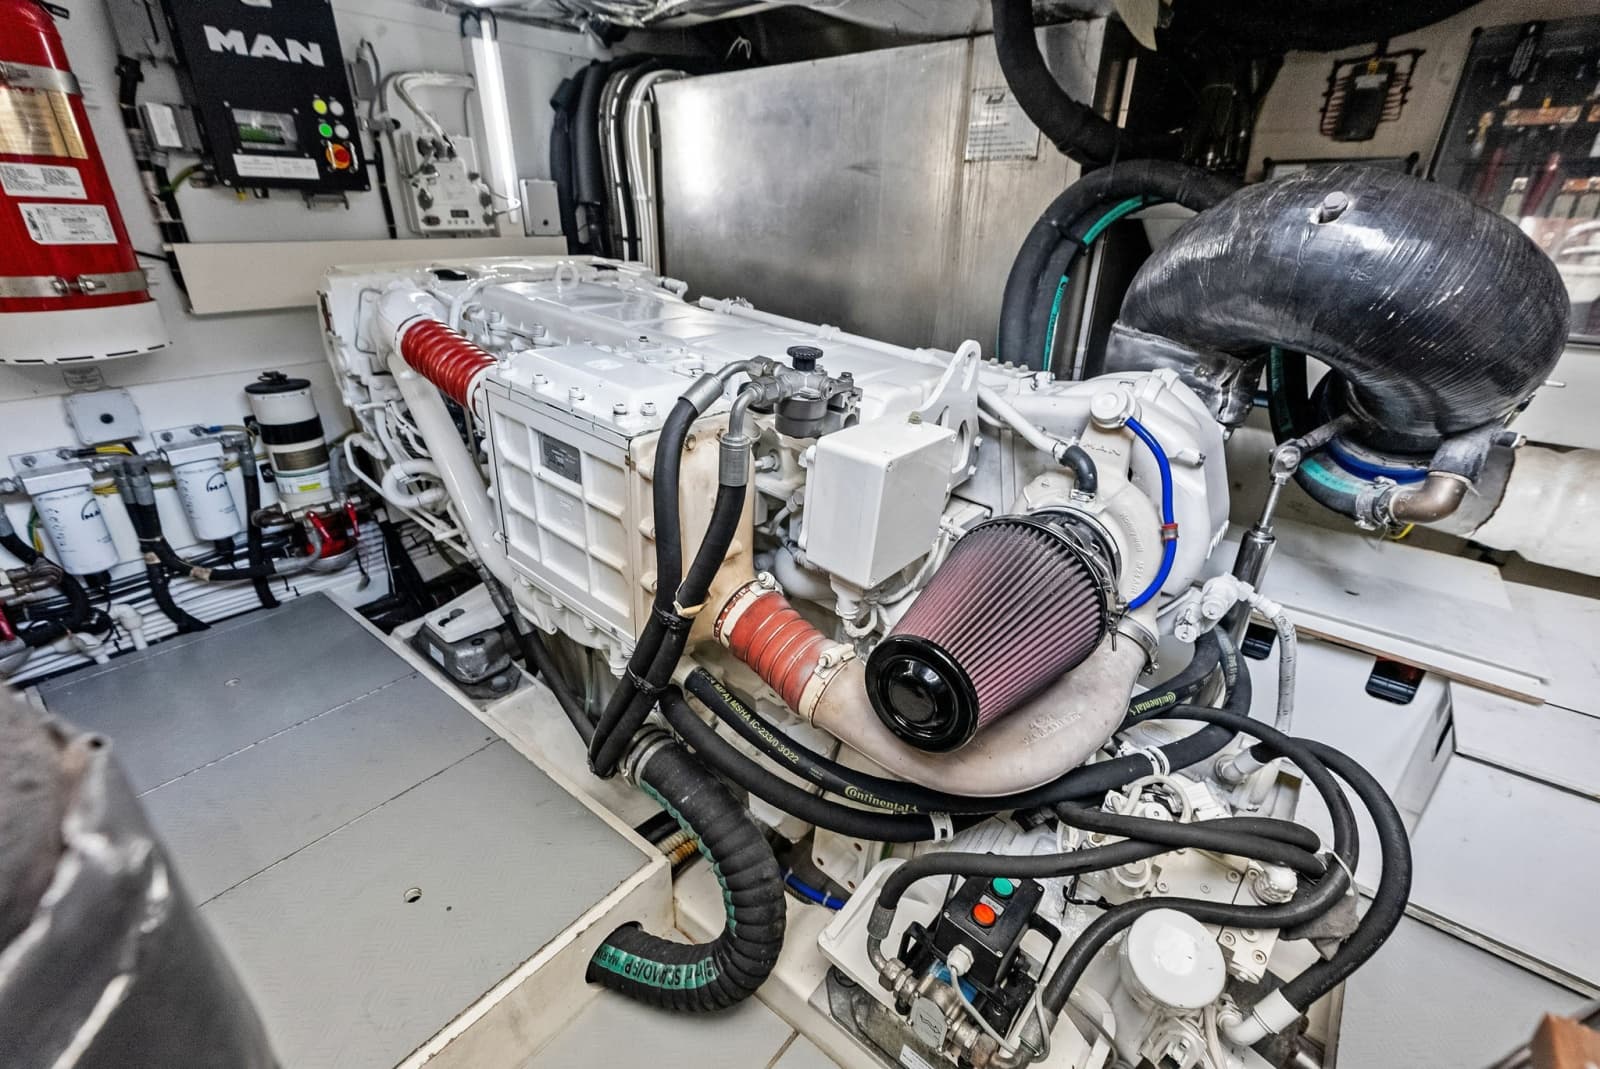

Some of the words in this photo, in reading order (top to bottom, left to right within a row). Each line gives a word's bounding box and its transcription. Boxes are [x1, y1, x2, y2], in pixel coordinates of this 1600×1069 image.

[203, 24, 325, 67] MAN
[730, 700, 751, 721] MSHA
[1135, 691, 1176, 713] Continental
[844, 784, 910, 812] Continental
